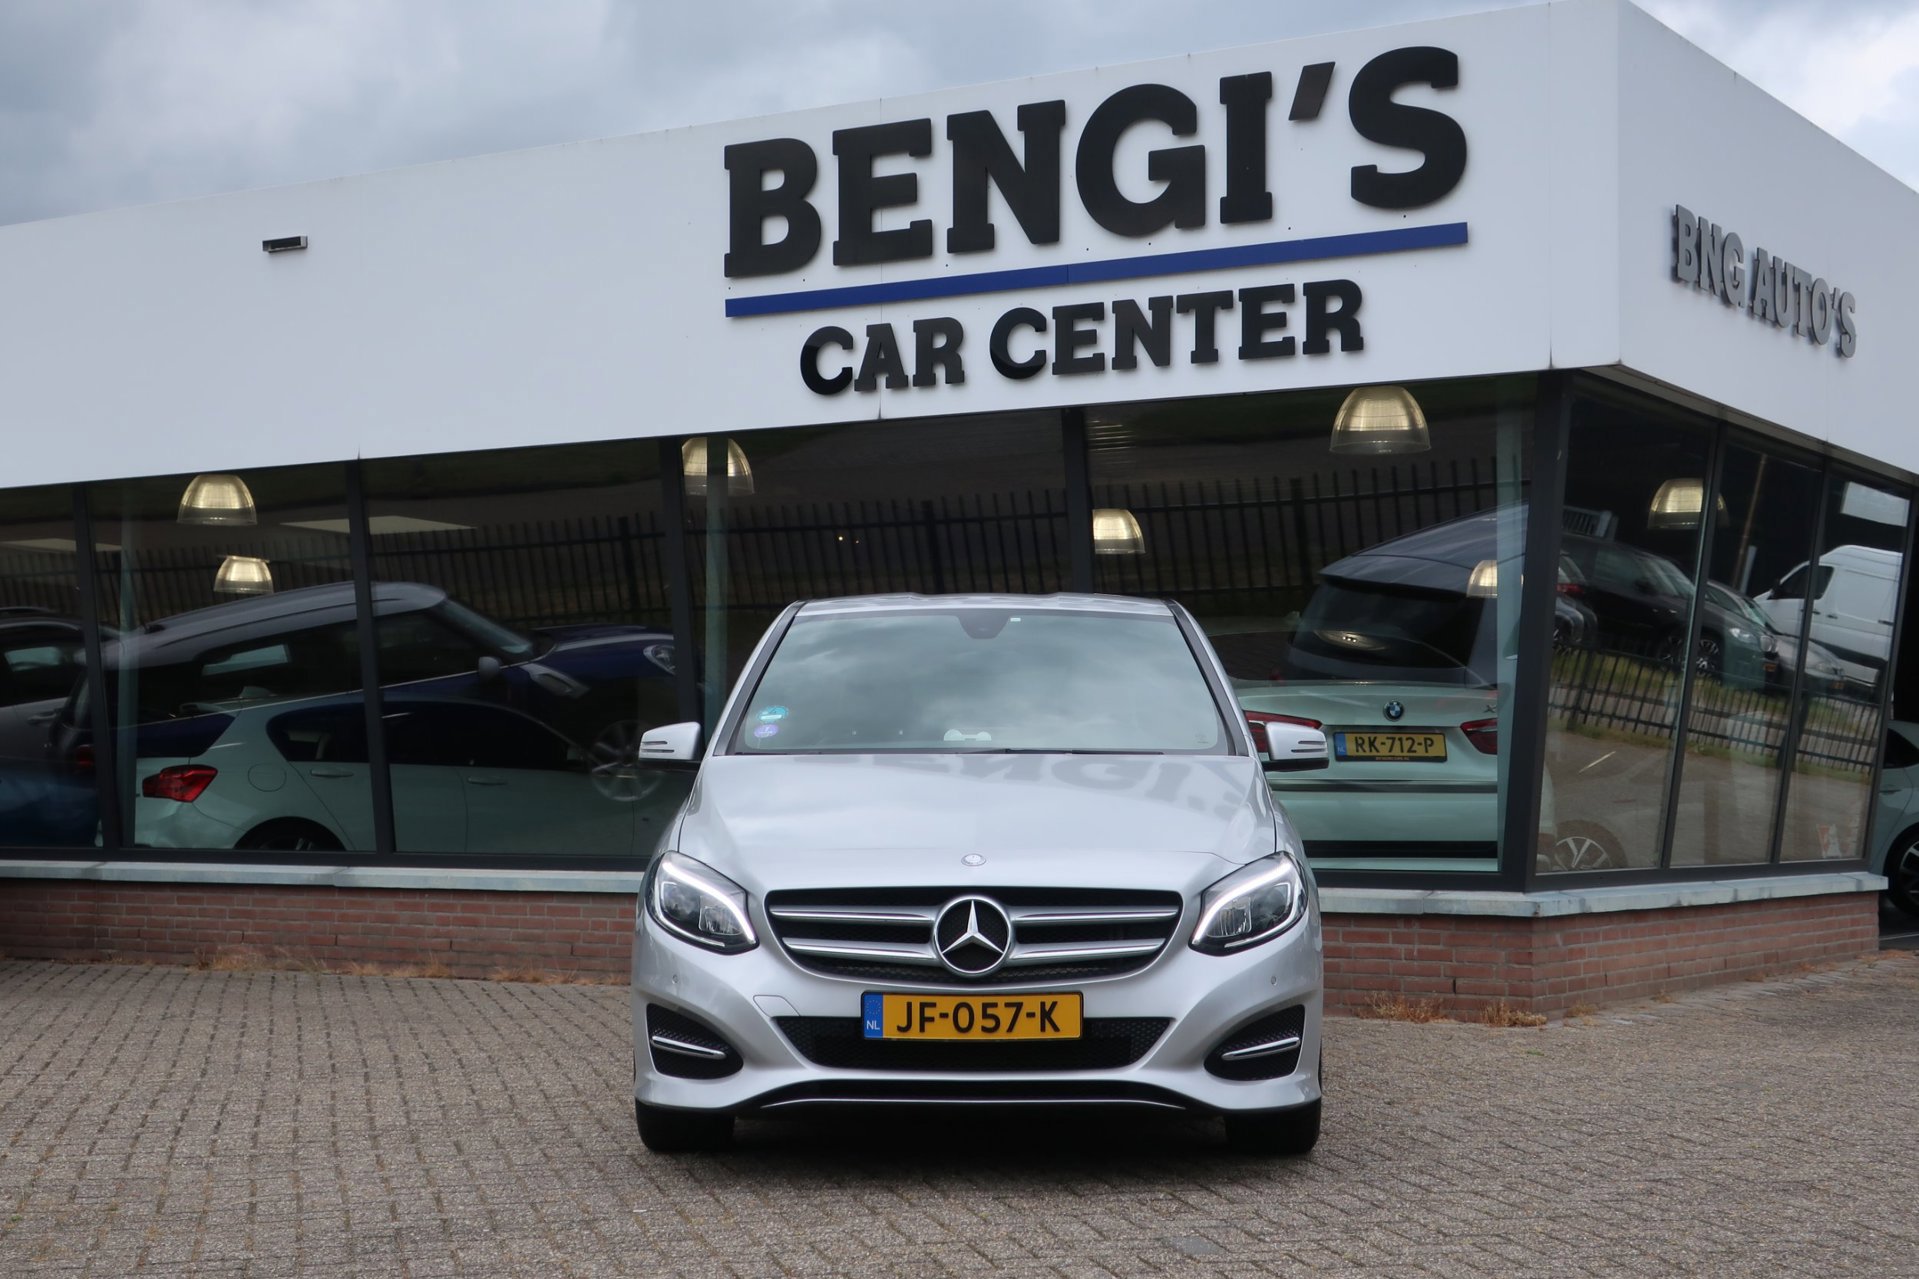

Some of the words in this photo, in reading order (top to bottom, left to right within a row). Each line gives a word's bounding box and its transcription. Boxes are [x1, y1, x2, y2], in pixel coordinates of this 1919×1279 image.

[724, 46, 1467, 277] BENGI'S
[1674, 204, 1746, 308] BNG
[1750, 247, 1856, 358] AUTO'S
[800, 317, 965, 395] CAR
[989, 279, 1364, 380] CENTER
[1354, 736, 1434, 753] RK-712-P
[866, 1020, 880, 1030] NL
[896, 1001, 1061, 1033] JF-057-K
